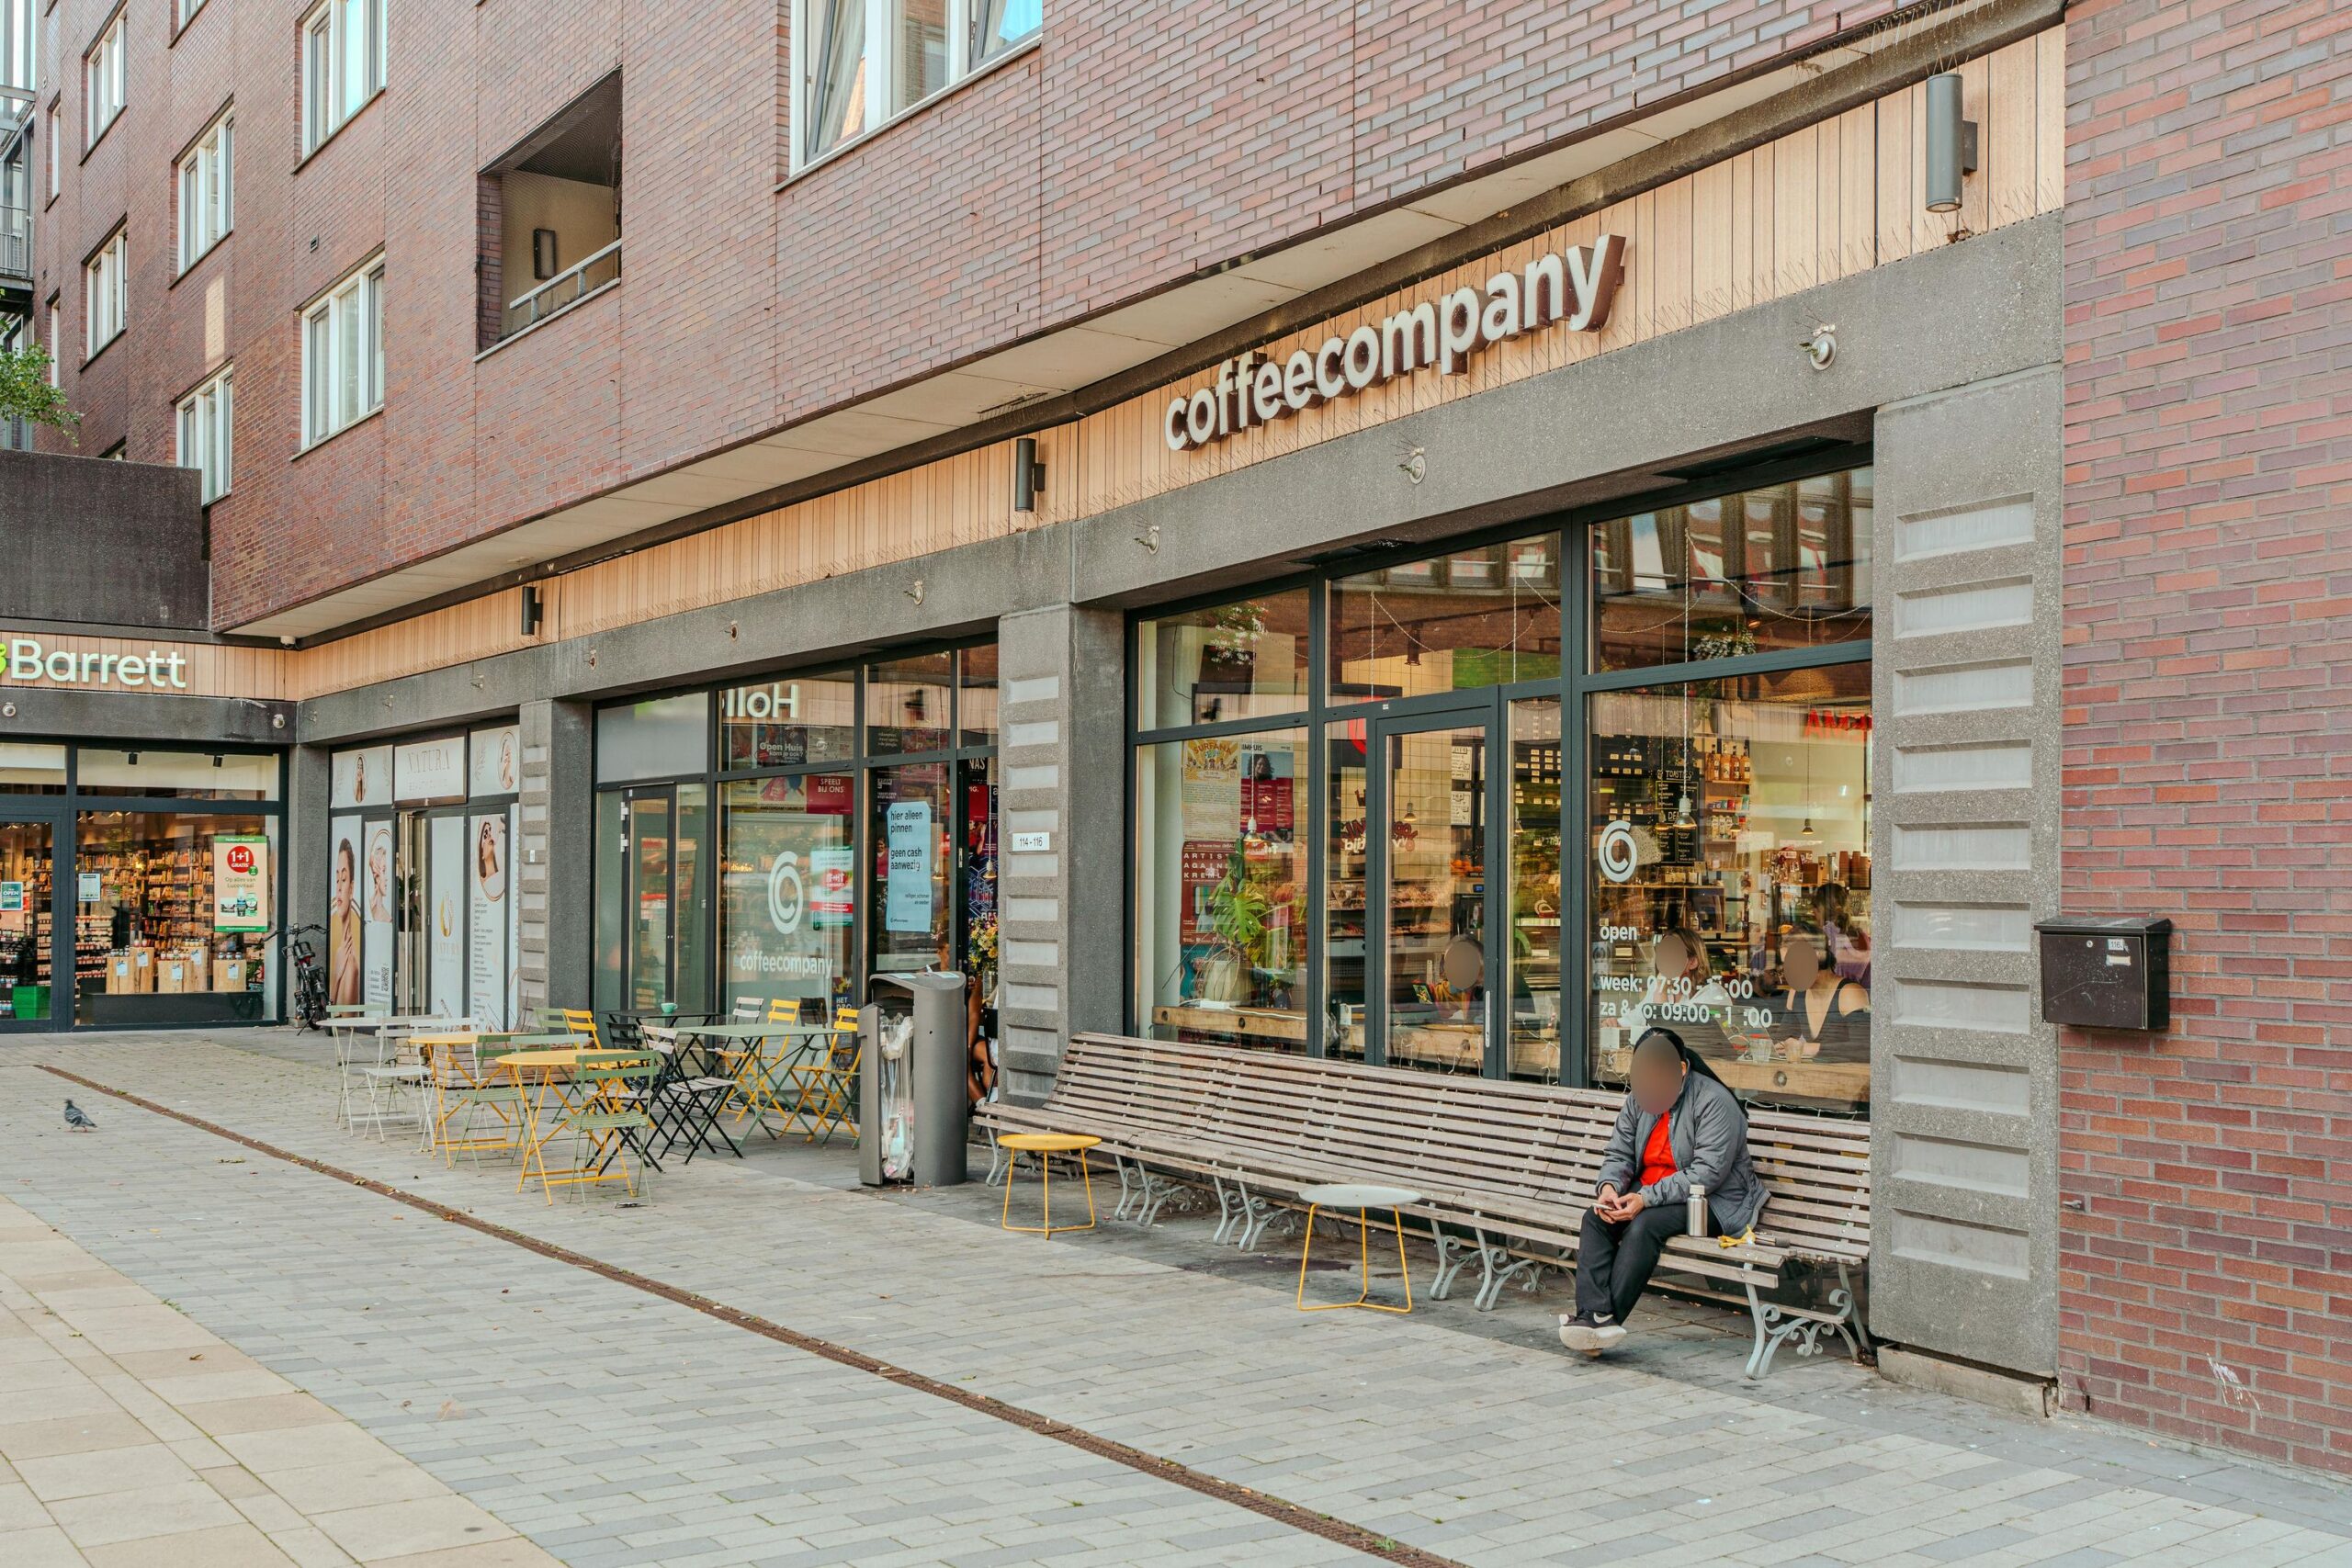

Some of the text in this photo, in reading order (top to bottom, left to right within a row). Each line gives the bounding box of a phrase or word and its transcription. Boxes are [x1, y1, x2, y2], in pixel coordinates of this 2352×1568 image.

[1165, 234, 1623, 451] coffeecompany
[11, 638, 187, 688] Barrett
[759, 742, 803, 753] Open Huis
[1193, 741, 1231, 754] SURFANA
[407, 749, 450, 773] NATURA
[890, 810, 923, 821] hier alleen
[890, 824, 912, 835] pinnen
[1019, 837, 1028, 847] 114
[1034, 836, 1043, 846] 116
[231, 851, 250, 863] 1+1
[890, 847, 922, 860] geen cash
[890, 860, 921, 872] aanwezig
[1600, 926, 1637, 943] open
[740, 950, 832, 979] coffeecompany
[1600, 974, 1643, 993] week:
[1646, 976, 1692, 996] 07:30
[1600, 1001, 1617, 1016] za
[1634, 1004, 1657, 1020] o:
[1661, 1002, 1711, 1023] 09:00
[1725, 1006, 1773, 1028] 1:00
